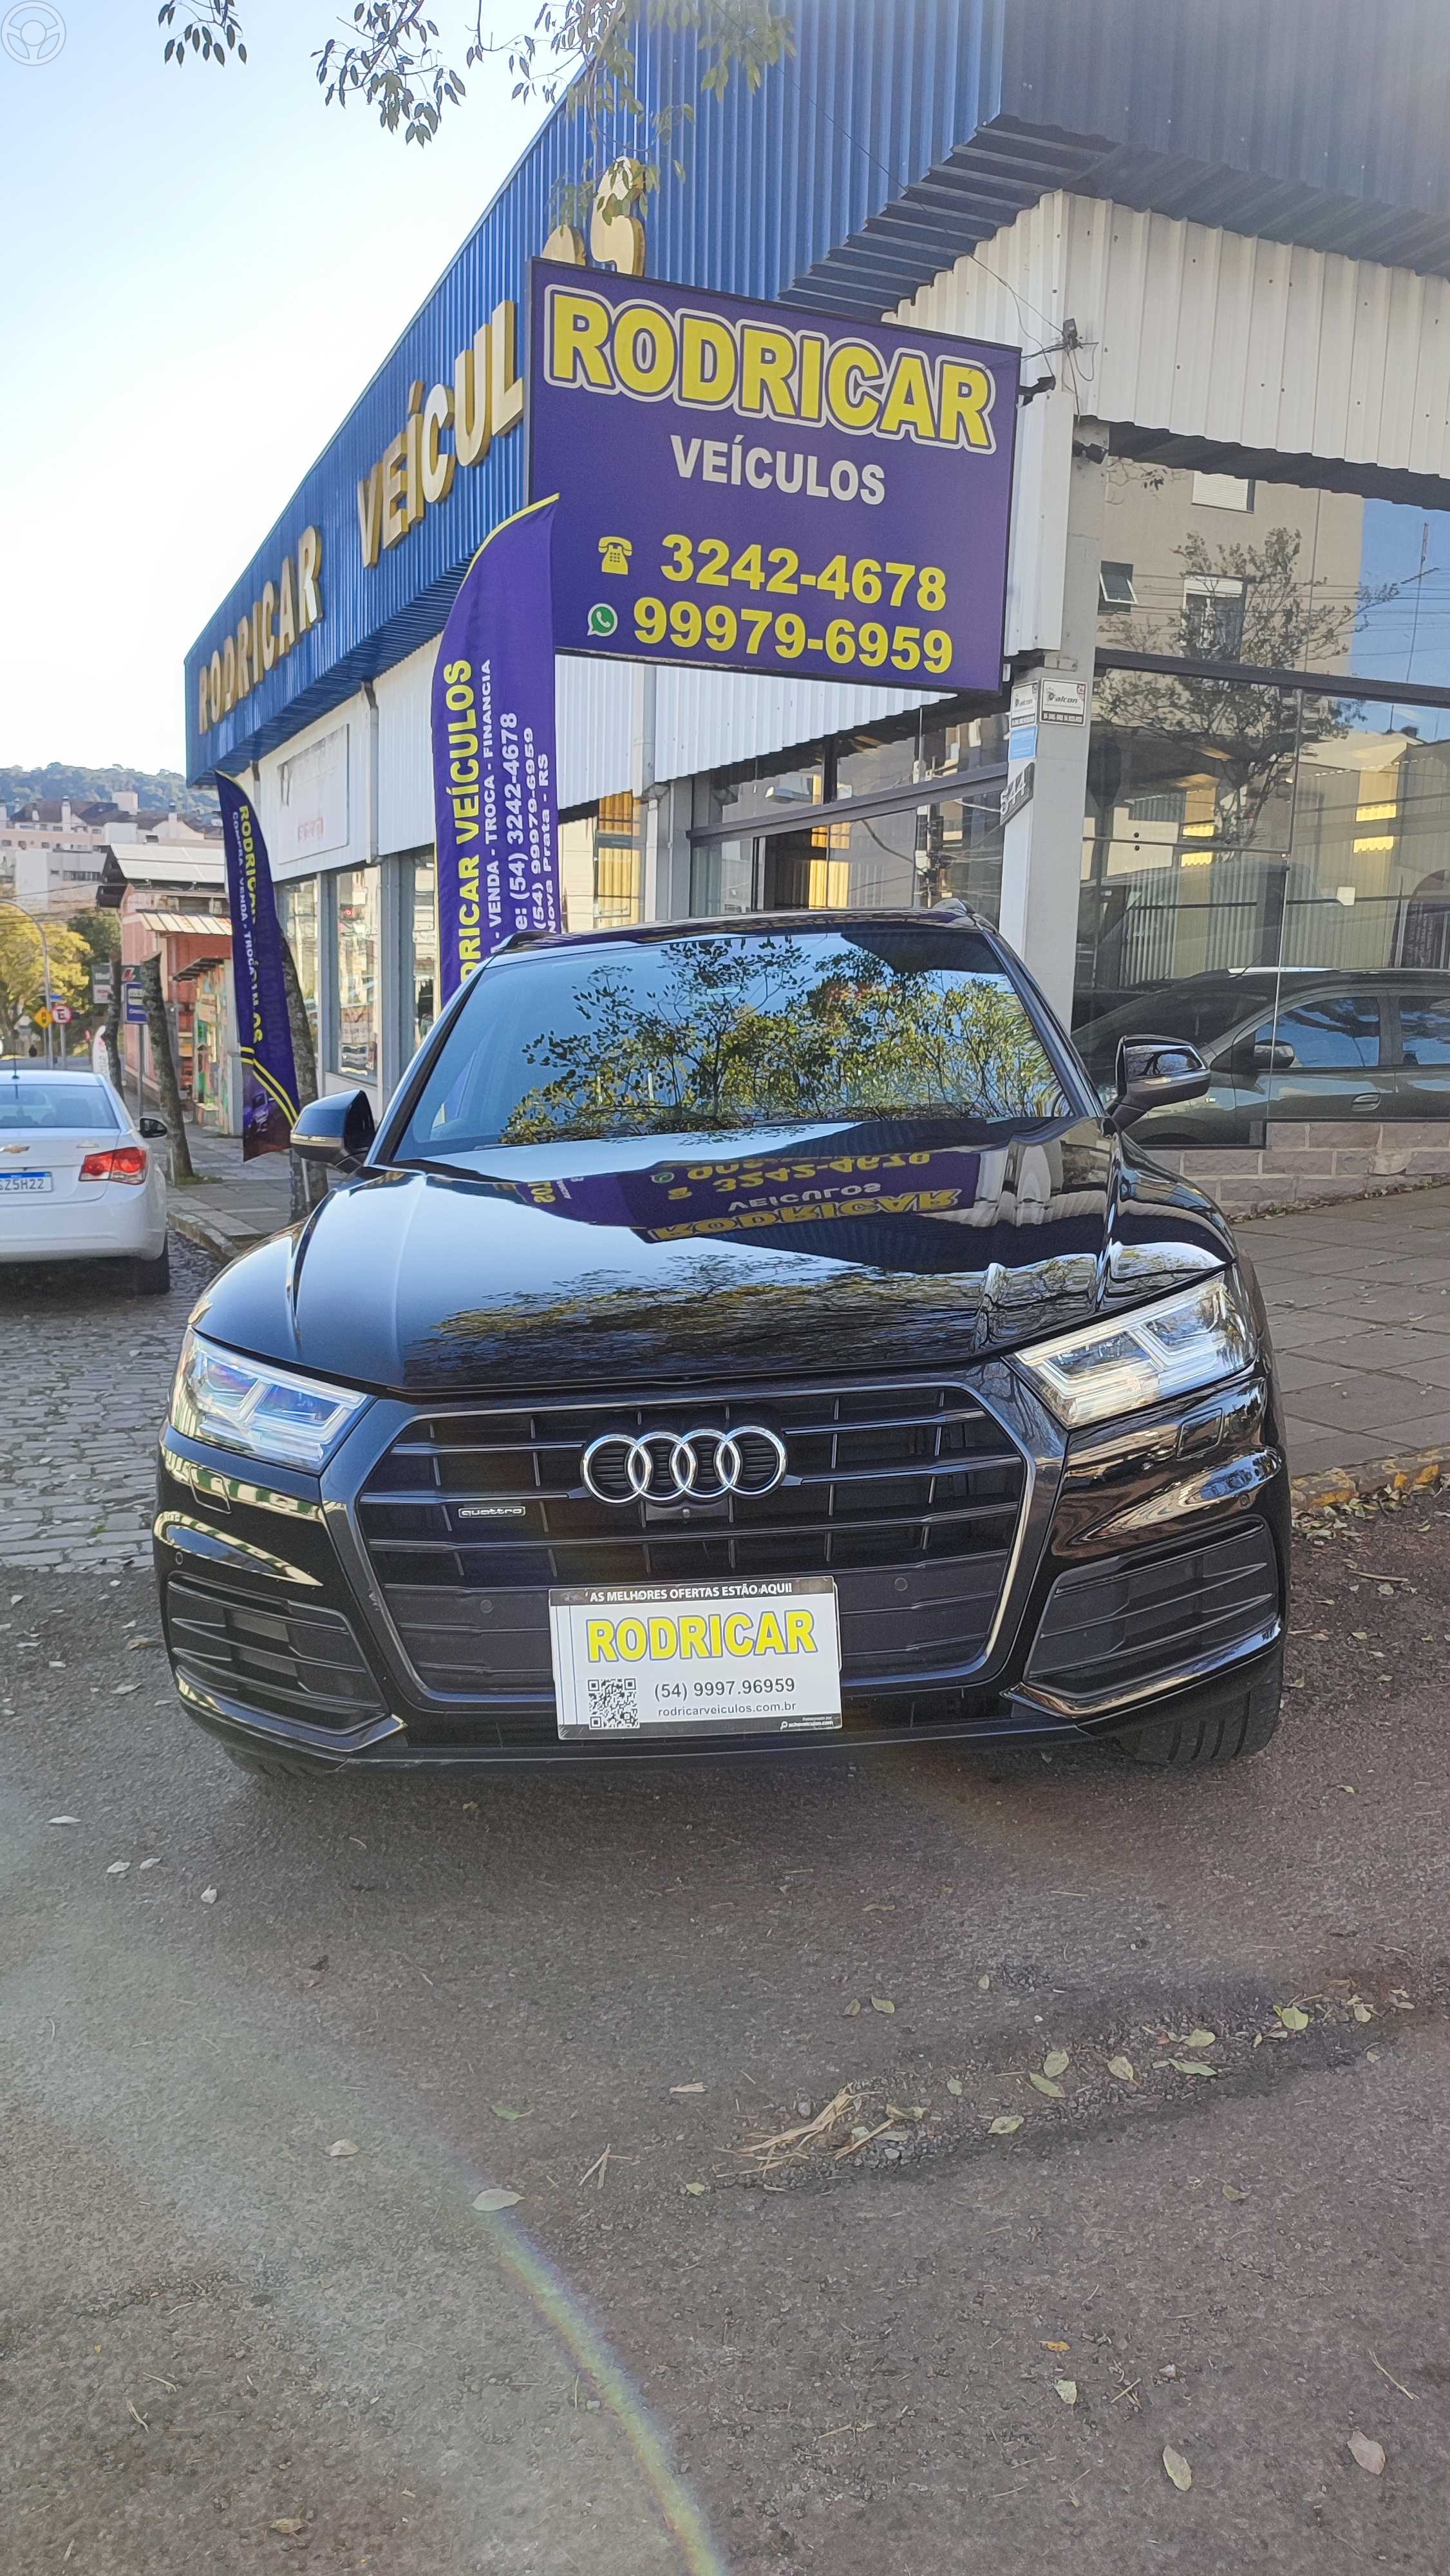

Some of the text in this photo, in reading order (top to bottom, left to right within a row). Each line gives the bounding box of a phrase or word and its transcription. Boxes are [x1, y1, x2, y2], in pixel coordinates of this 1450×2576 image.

[545, 284, 997, 455] RODRICAR
[670, 435, 885, 505] VEÍCULOS
[661, 533, 946, 612] 3242-4678
[198, 525, 323, 735] RODRICAR
[634, 596, 953, 674] 99979-6959
[482, 660, 494, 758] FINANCIA
[500, 712, 524, 845] 3242-4678
[537, 753, 550, 787] RS
[1000, 769, 1026, 815] 544
[443, 659, 481, 983] DRICAR VEÍCULOS
[484, 775, 497, 844] TROCA
[523, 727, 547, 930] (54) 99979-6959
[540, 808, 552, 872] Prata
[487, 861, 502, 927] VENDA
[509, 853, 530, 900] (54)
[244, 931, 255, 975] TROCA
[461, 1508, 523, 1517] quattro
[590, 1591, 605, 1602] AS
[607, 1589, 668, 1602] MELHORES
[670, 1587, 720, 1599] OFERTAS
[722, 1583, 758, 1597] ESTÃO
[586, 1609, 818, 1663] RODRICAR
[654, 1677, 796, 1701] (54) 9997.96959
[657, 1701, 796, 1717] rodricarveiculos.com.br
